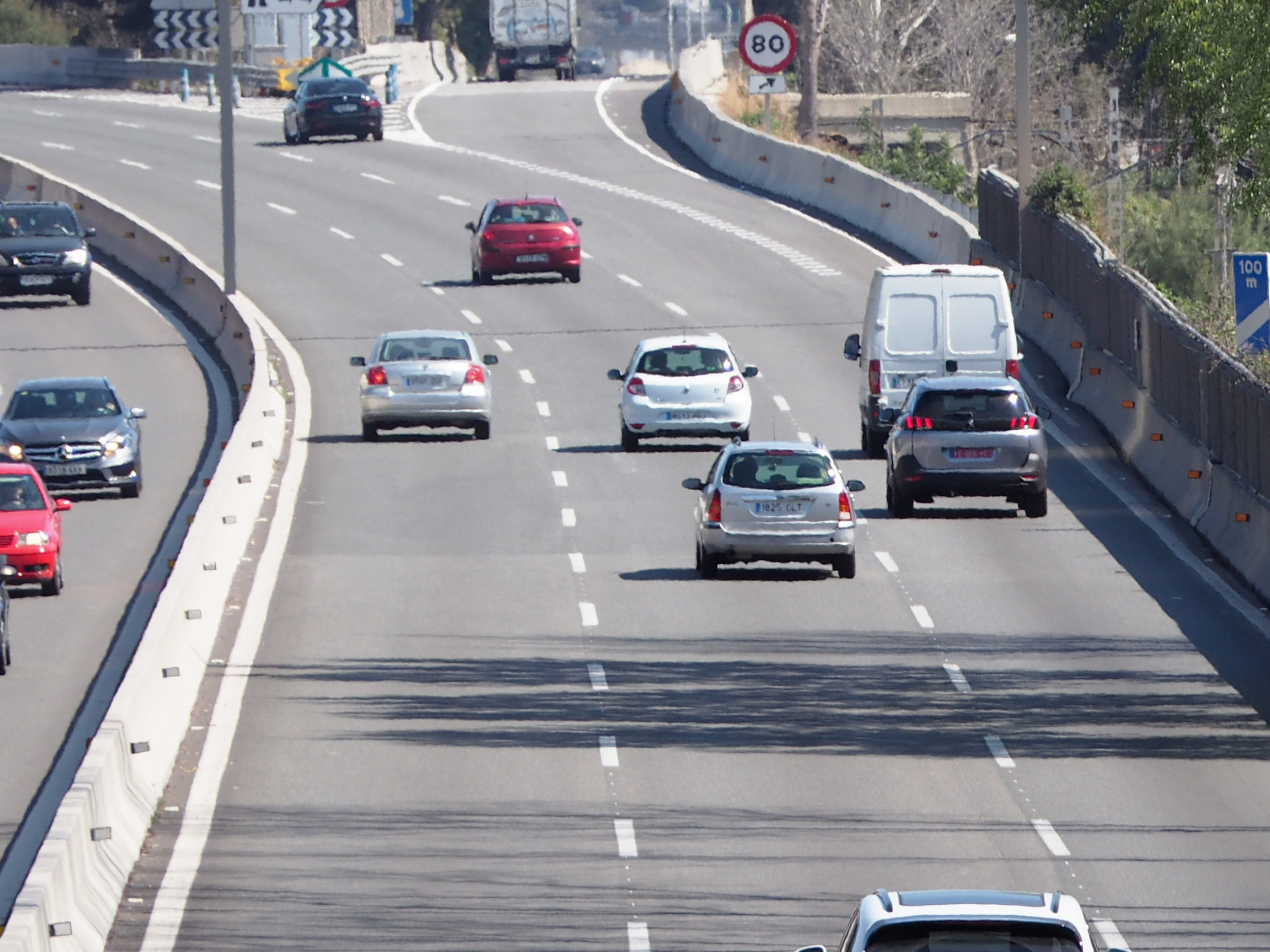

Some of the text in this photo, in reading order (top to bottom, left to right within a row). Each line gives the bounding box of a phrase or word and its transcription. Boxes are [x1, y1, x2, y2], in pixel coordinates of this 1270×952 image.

[751, 34, 784, 54] 80
[1238, 259, 1263, 276] 100
[1245, 277, 1258, 289] m
